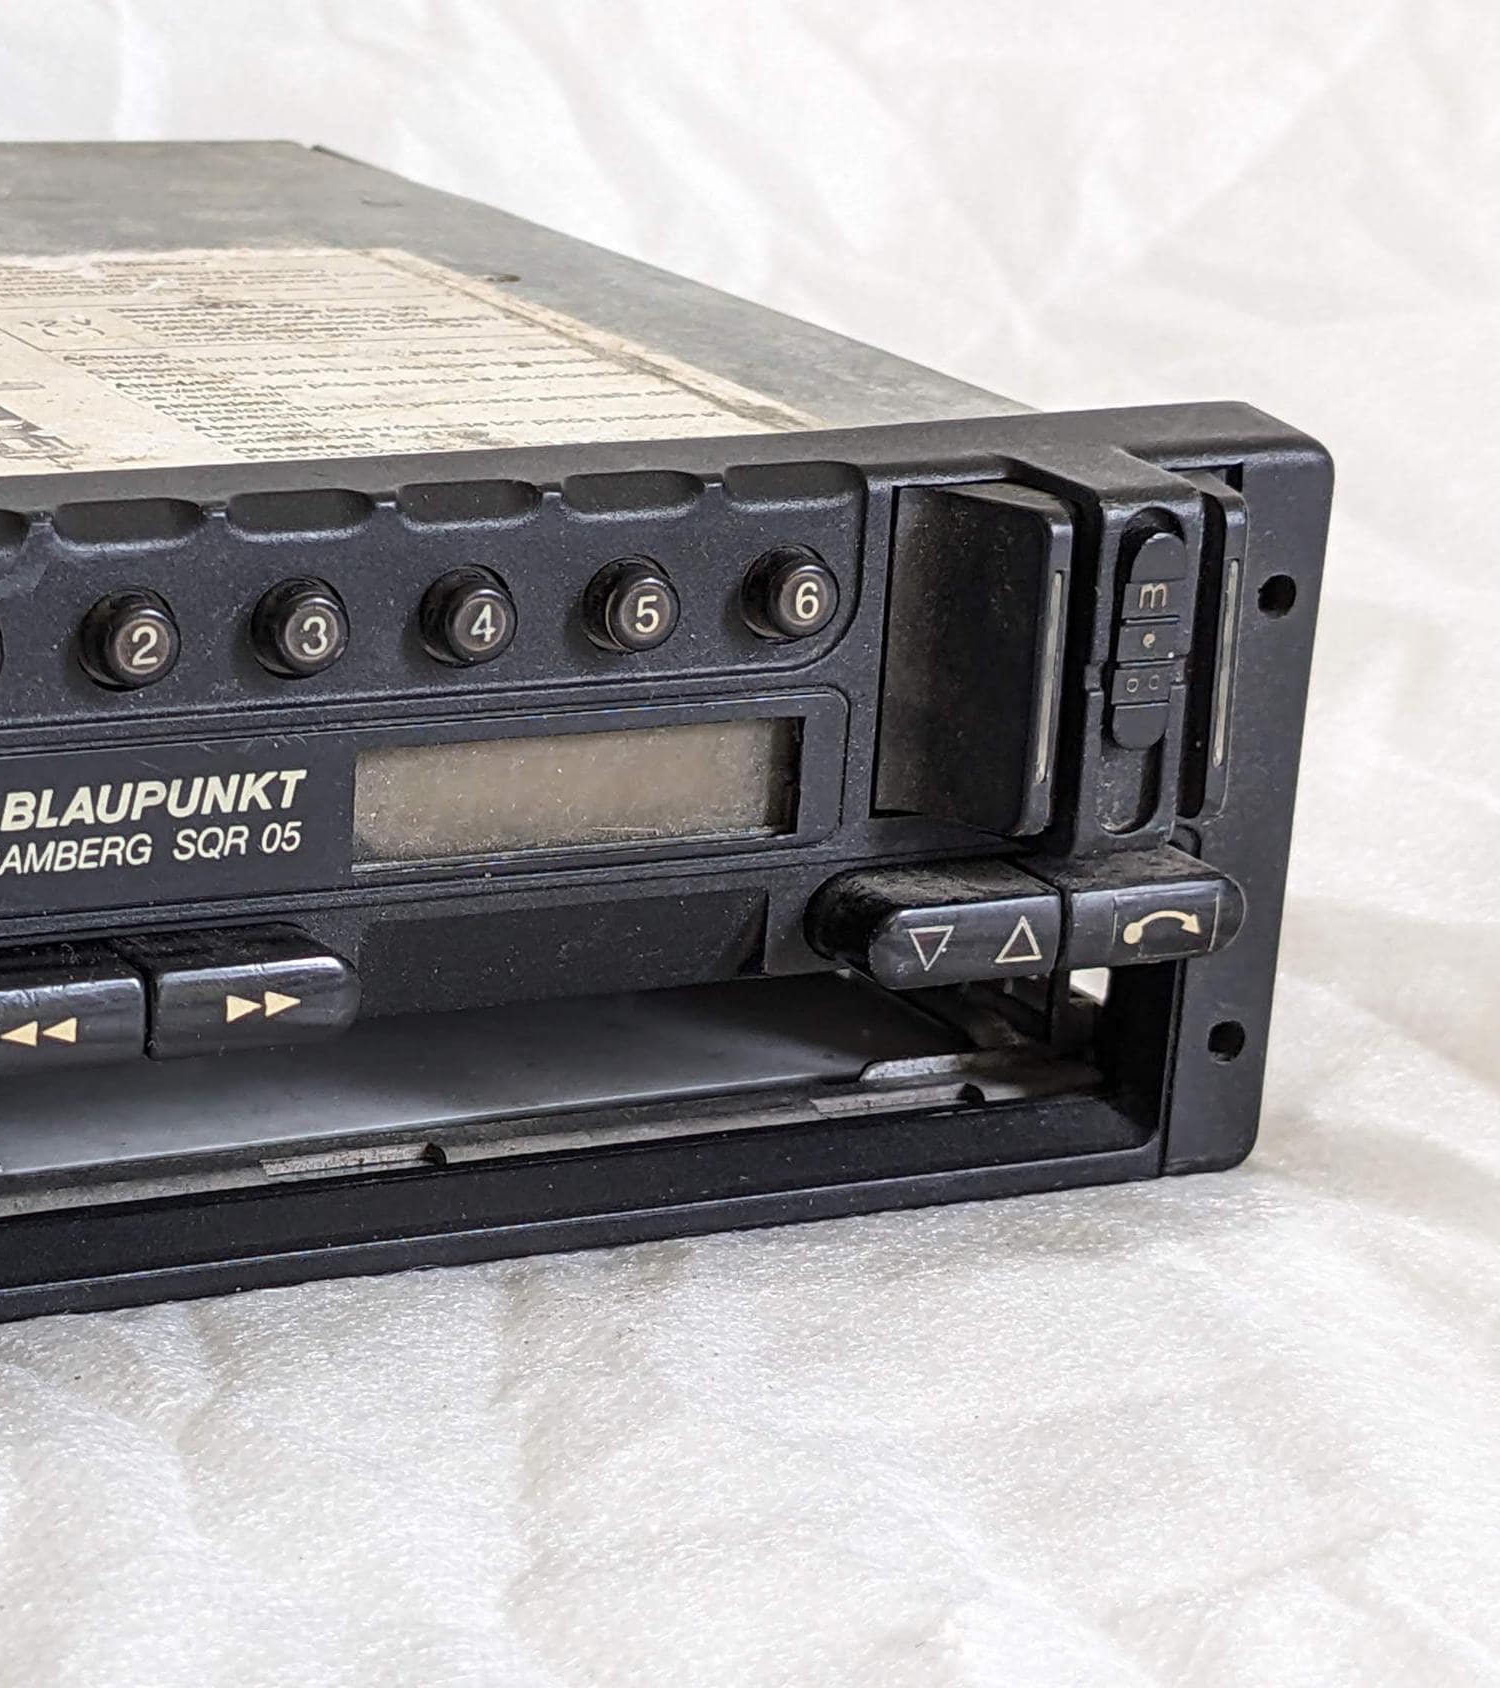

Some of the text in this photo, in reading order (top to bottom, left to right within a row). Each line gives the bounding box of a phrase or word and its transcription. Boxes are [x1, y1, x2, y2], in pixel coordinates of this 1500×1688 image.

[635, 596, 660, 633] 5
[796, 582, 819, 620] 6
[302, 616, 328, 660] 3
[471, 604, 497, 643] 4
[128, 626, 158, 674] 2
[1, 769, 307, 832] BLAUPUNKT
[173, 831, 248, 862] SQR
[261, 821, 303, 854] 05
